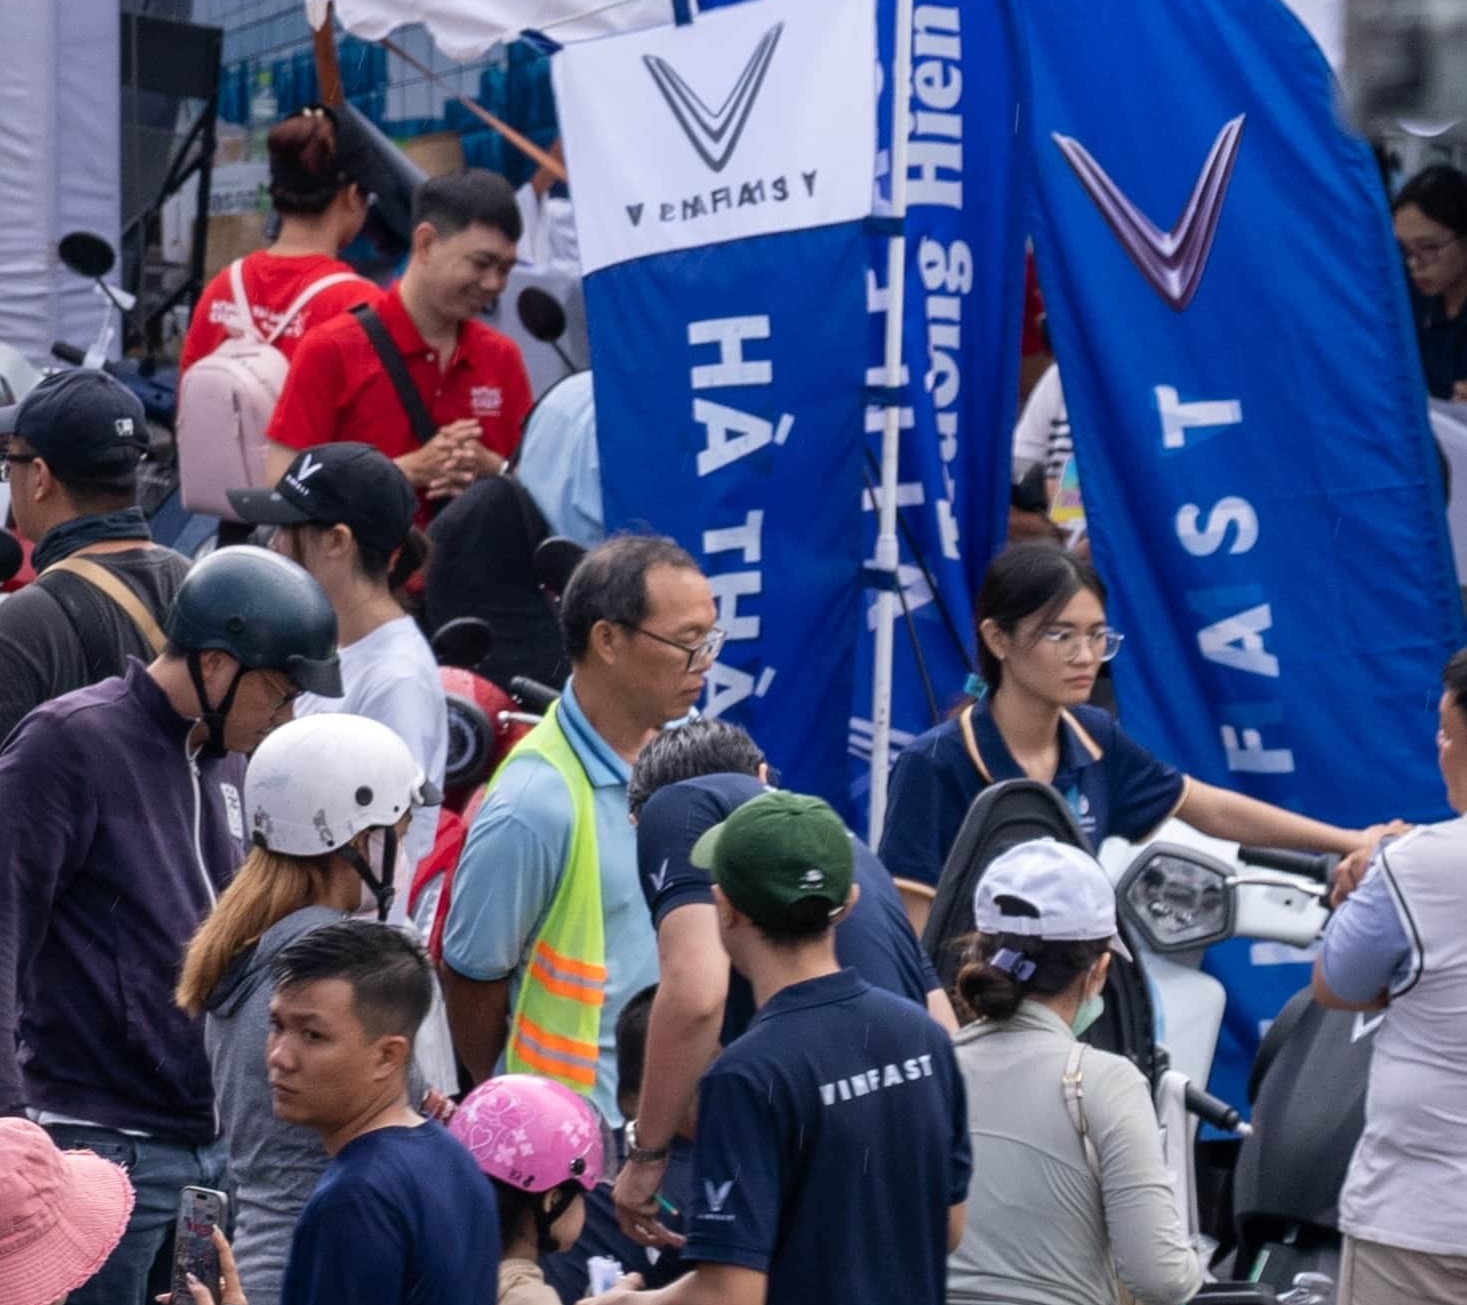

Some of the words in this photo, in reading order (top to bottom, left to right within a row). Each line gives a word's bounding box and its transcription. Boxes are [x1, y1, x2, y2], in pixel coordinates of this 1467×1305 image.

[687, 314, 794, 478] HÀ
[702, 509, 776, 721] THÀ
[1154, 383, 1296, 774] FAST
